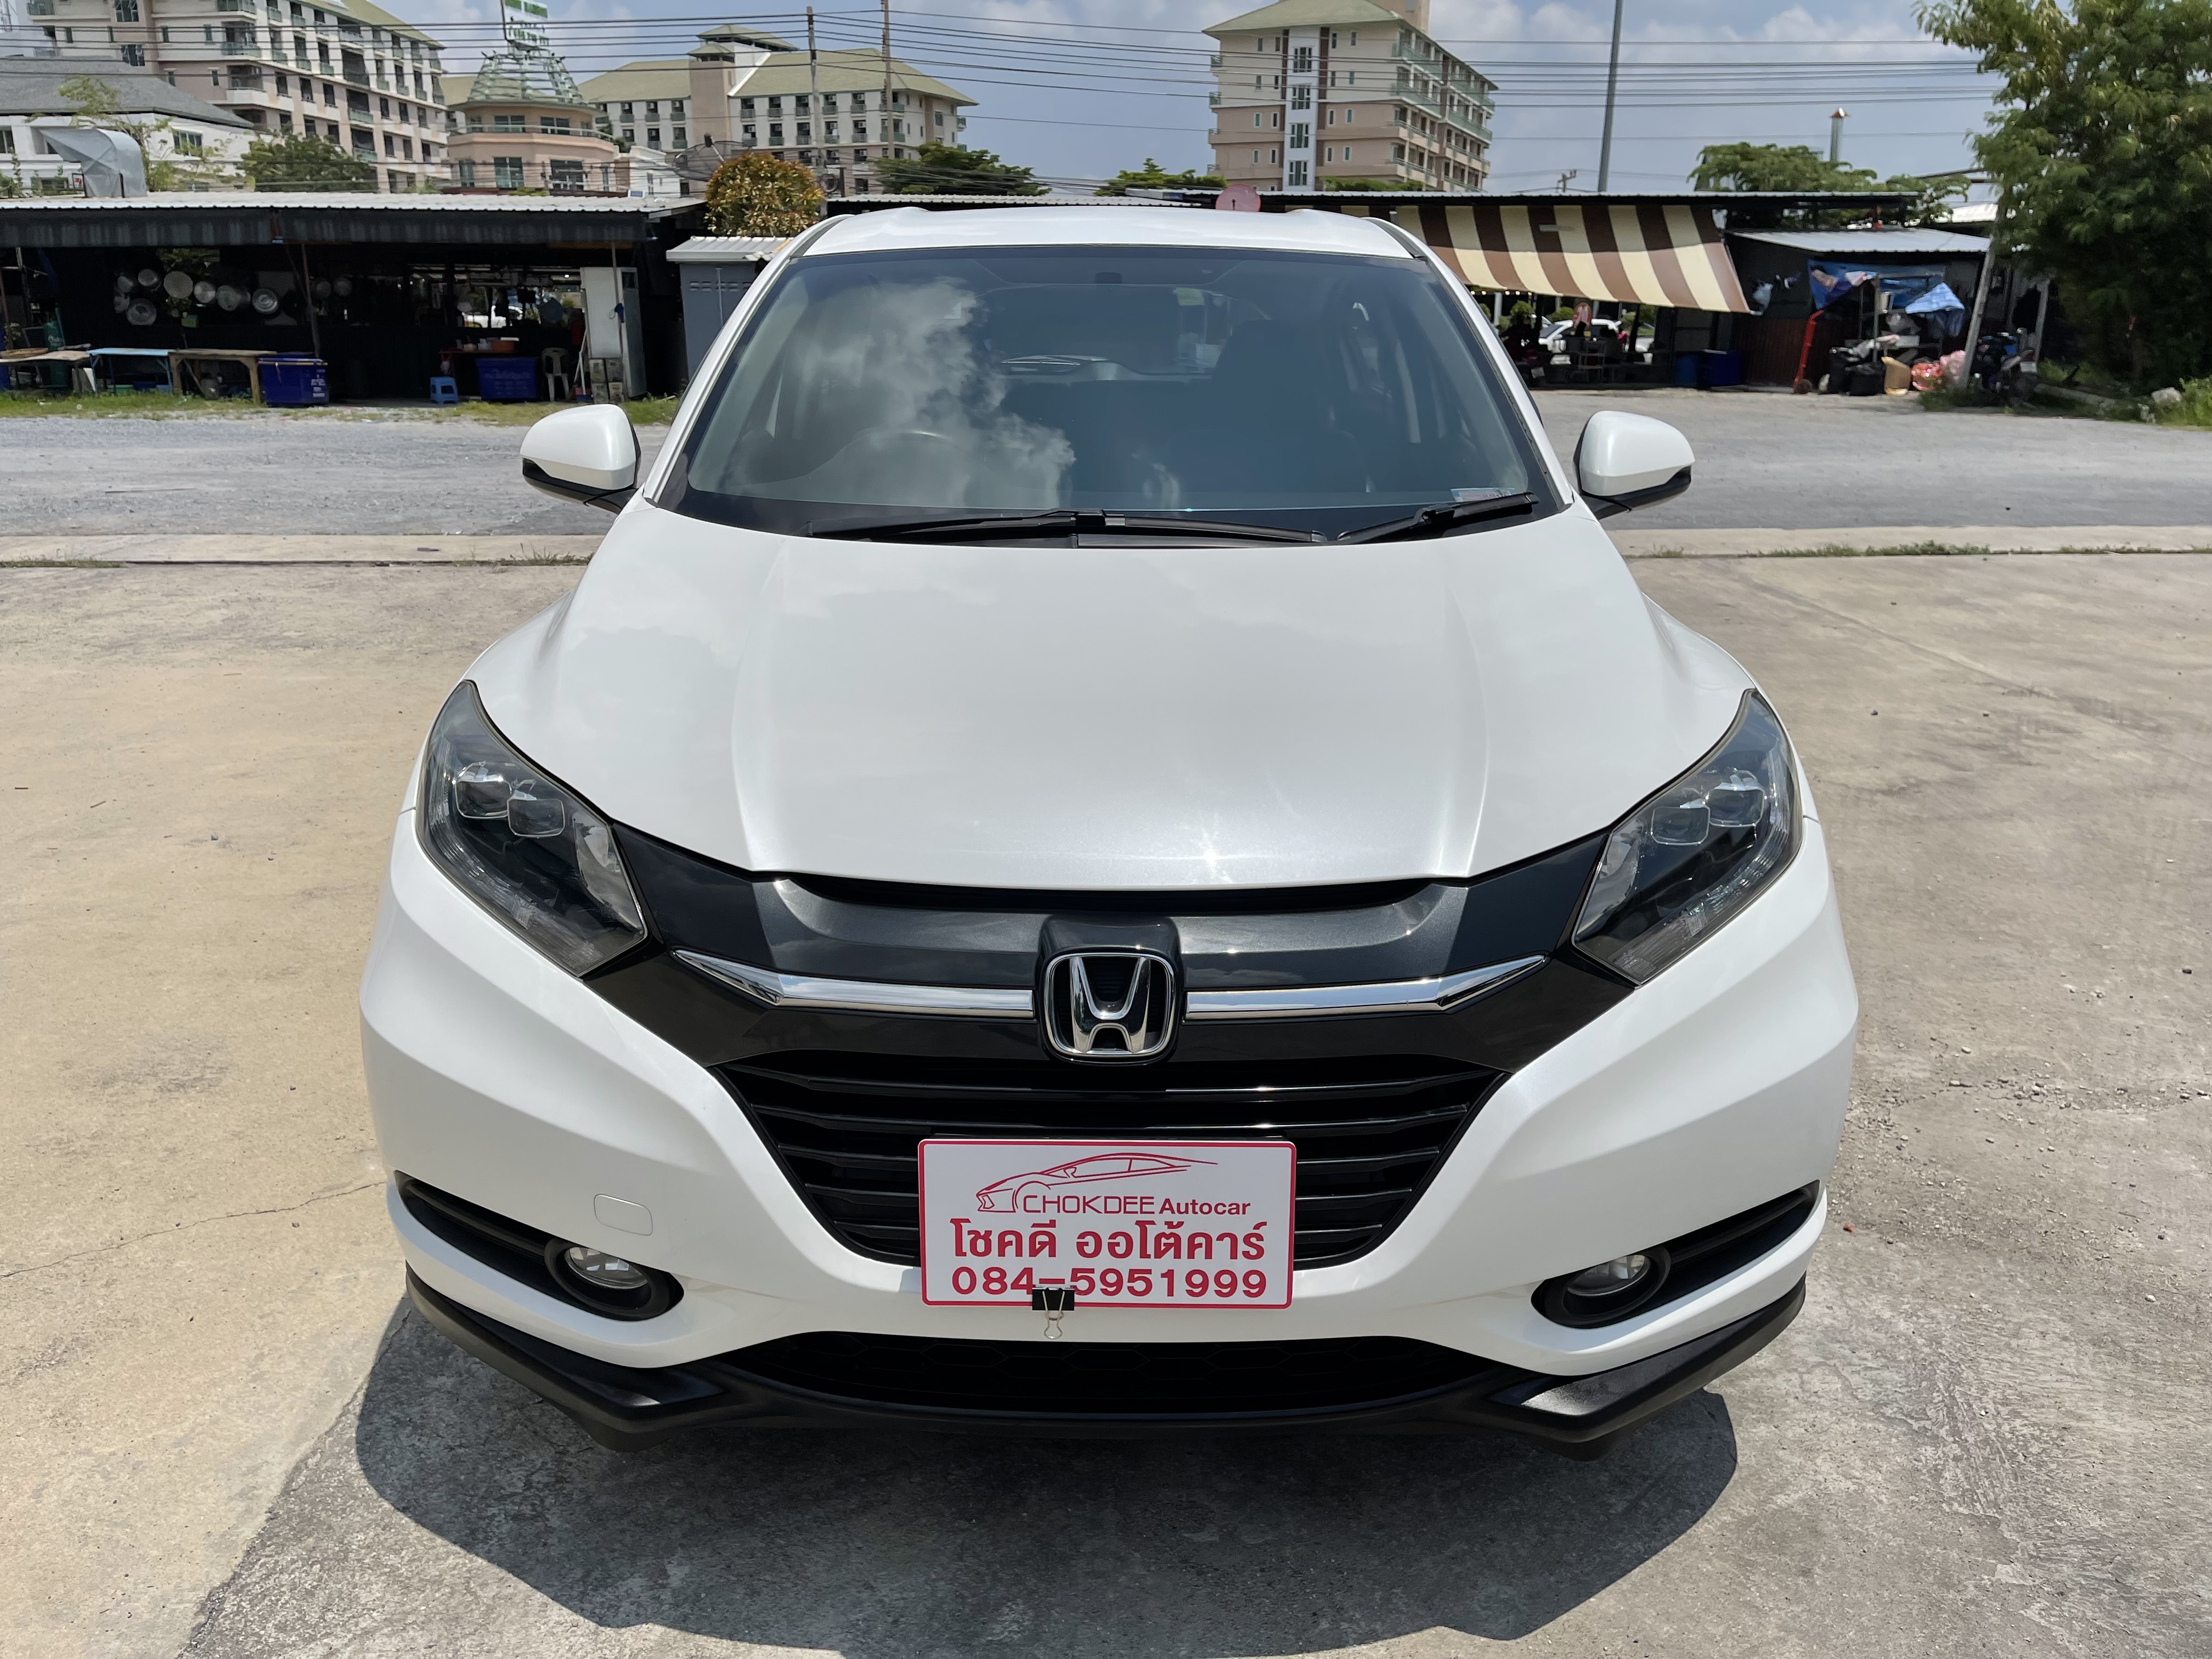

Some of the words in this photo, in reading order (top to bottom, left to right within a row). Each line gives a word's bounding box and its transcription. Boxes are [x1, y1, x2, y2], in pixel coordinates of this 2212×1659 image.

[1023, 1194, 1155, 1215] CHOKDEE
[1159, 1198, 1251, 1216] Autocar
[950, 1217, 1057, 1258] โชคดี
[1076, 1220, 1267, 1260] ออโต้คาร์
[952, 1266, 1267, 1299] 084-5951999
